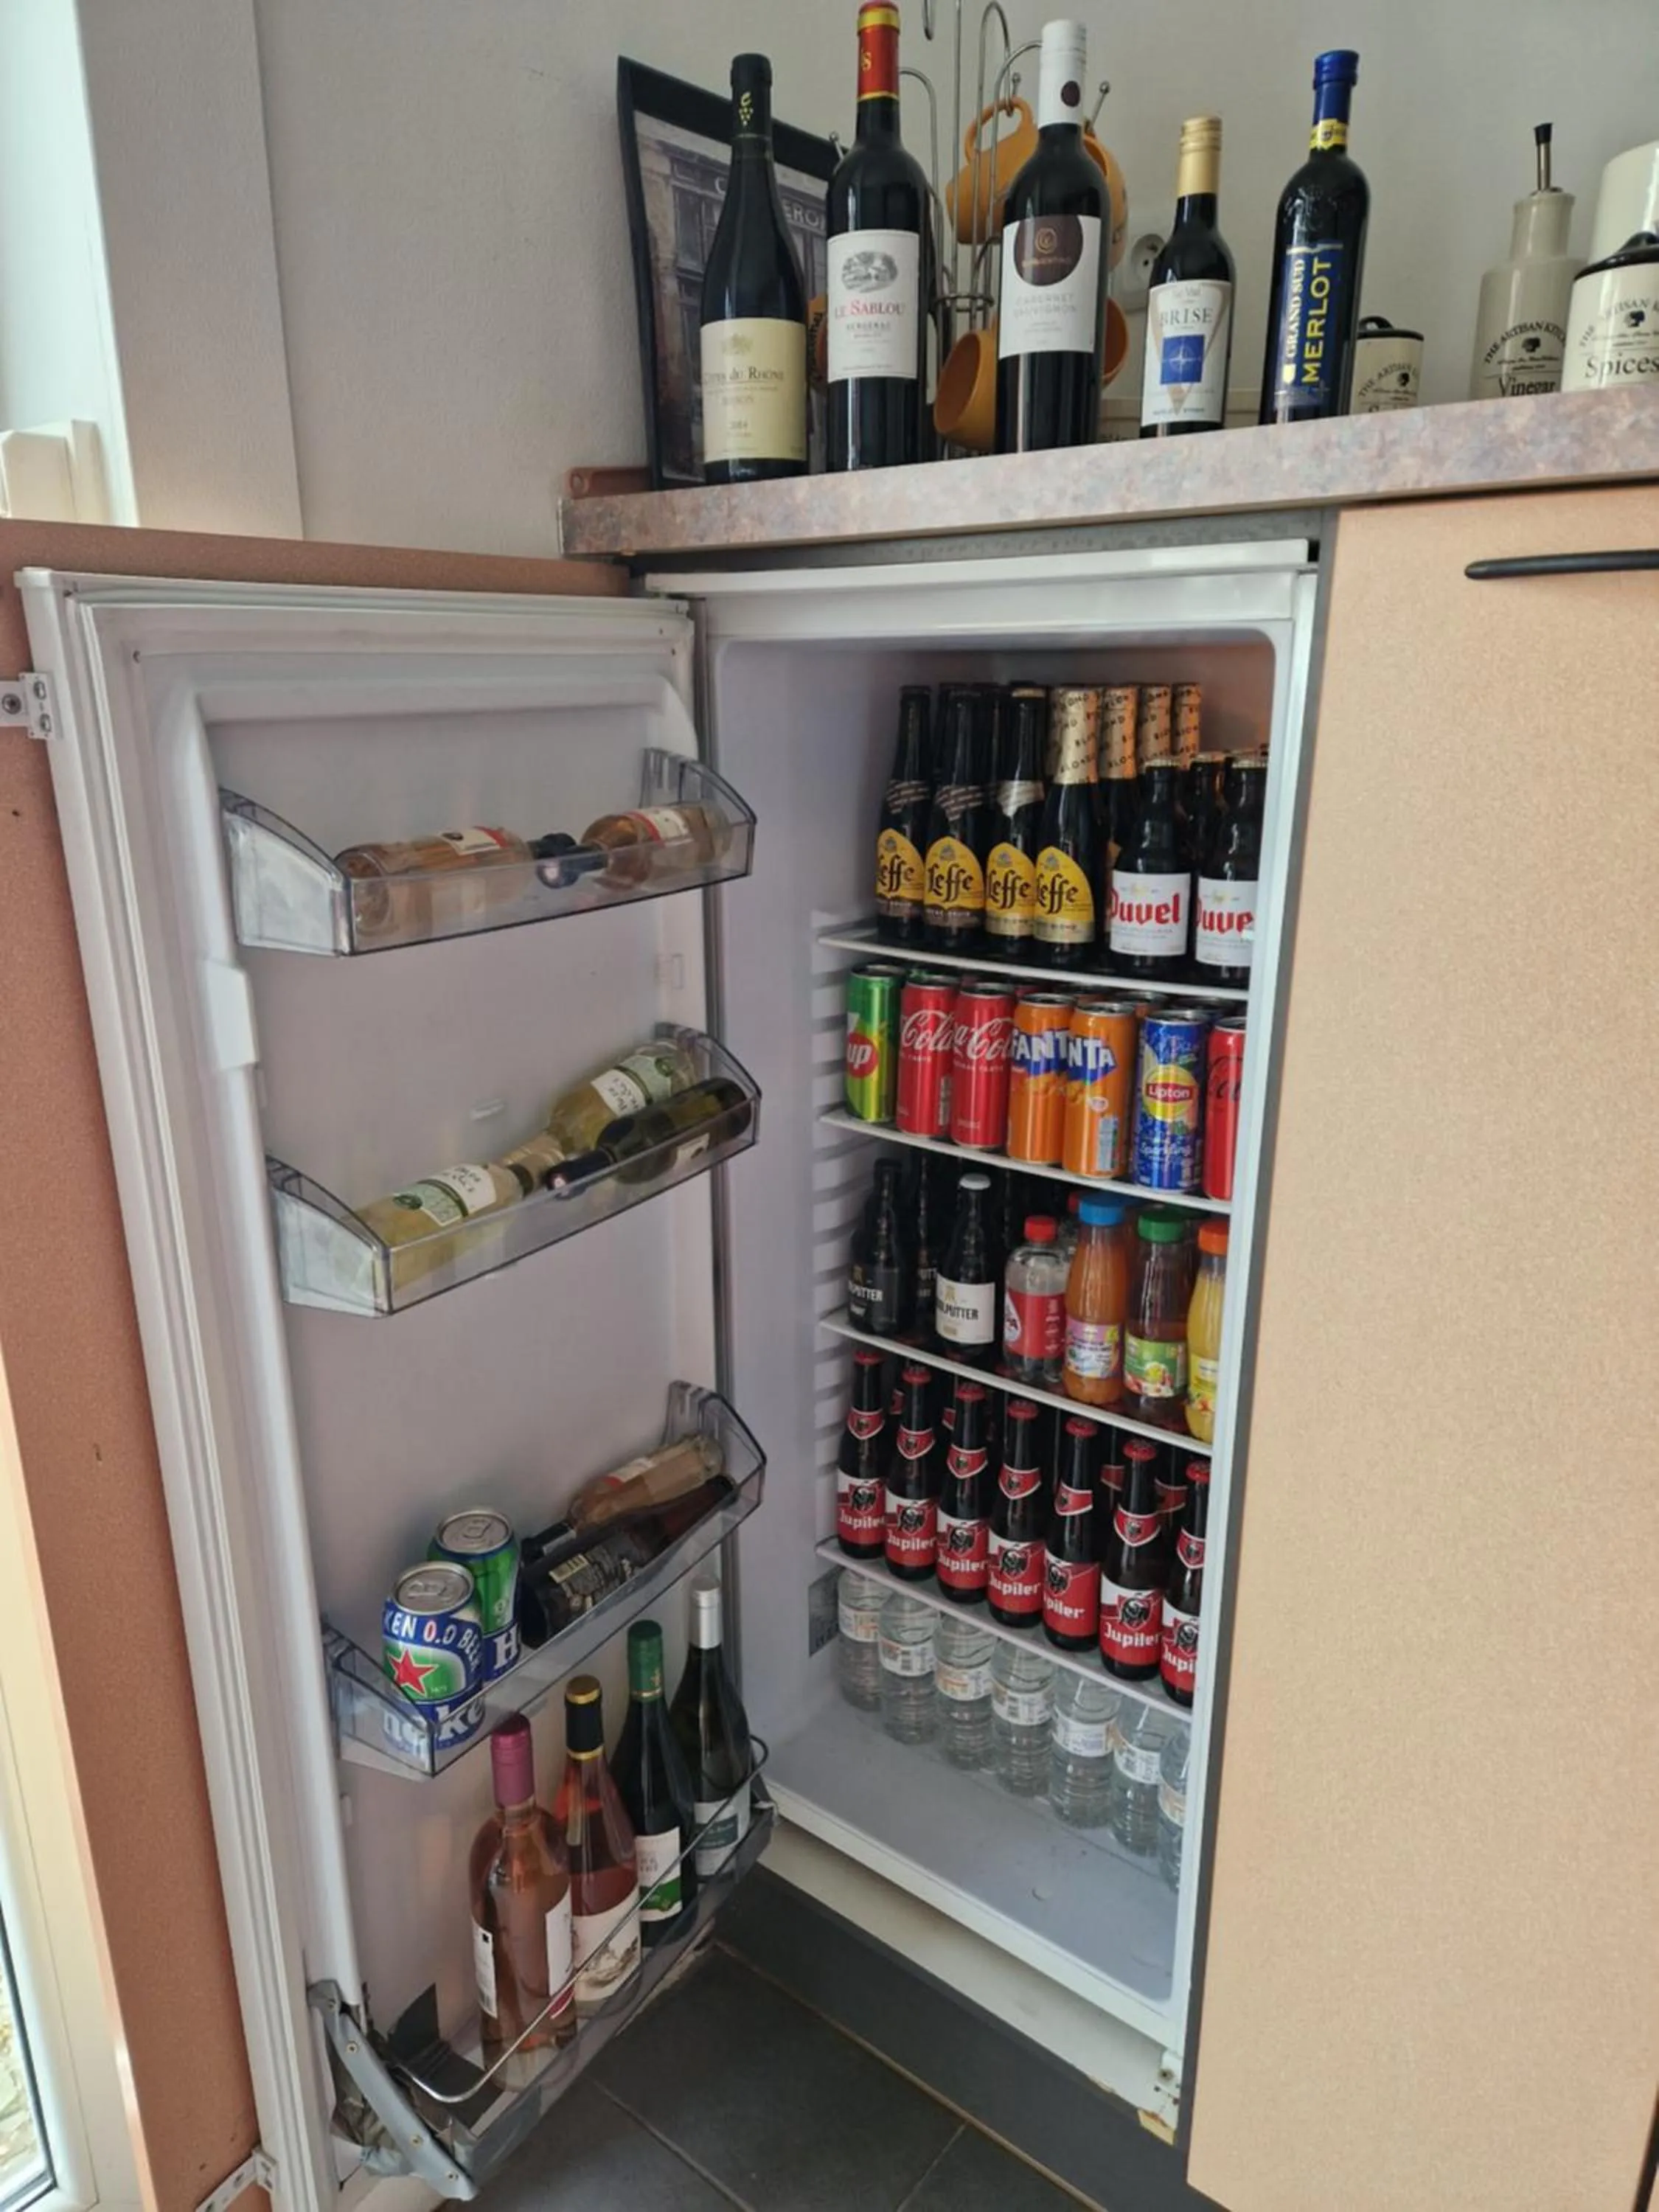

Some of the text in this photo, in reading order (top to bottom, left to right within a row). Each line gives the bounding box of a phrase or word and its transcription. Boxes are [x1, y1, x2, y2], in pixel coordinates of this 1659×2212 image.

[850, 300, 903, 316] SABLOU
[1160, 307, 1214, 326] BRISE
[1301, 256, 1332, 383] MERLOT
[1585, 351, 1659, 386] Spices
[927, 862, 974, 903] Leffe
[1148, 1084, 1191, 1100] Lipton
[887, 1528, 936, 1551] Jupiler
[939, 1548, 987, 1572] Jupiler
[989, 1572, 1040, 1596] Jupiler
[1104, 1622, 1160, 1649] Jupiler
